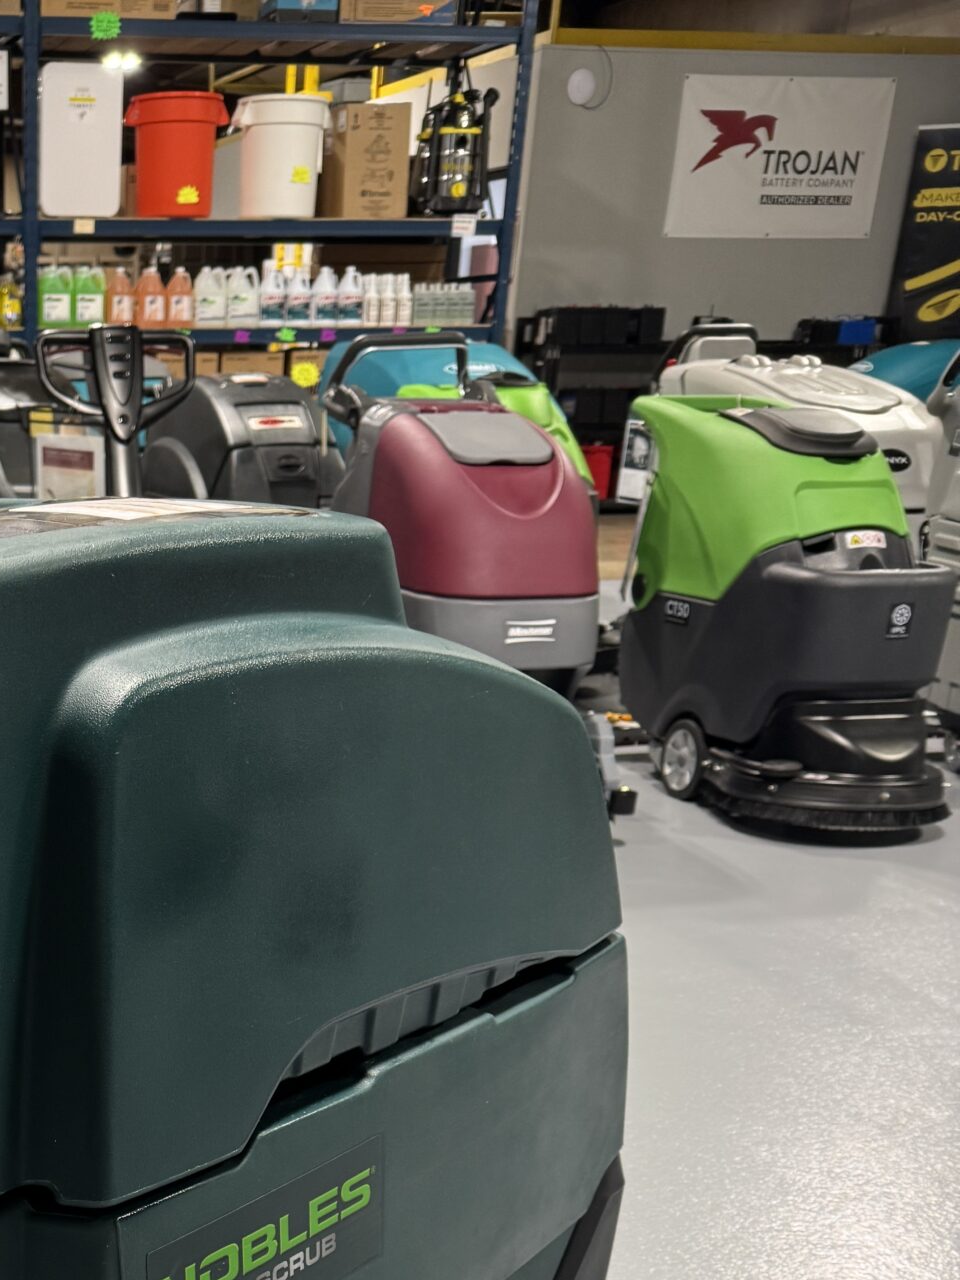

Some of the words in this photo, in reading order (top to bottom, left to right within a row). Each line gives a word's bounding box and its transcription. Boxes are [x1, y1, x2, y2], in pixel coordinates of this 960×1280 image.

[762, 150, 860, 176] TROJAN
[761, 178, 804, 188] BATTERY
[807, 178, 855, 188] COMPANY
[761, 195, 816, 205] AUTHORIZED
[818, 196, 852, 205] DEALER
[666, 601, 690, 618] CT50
